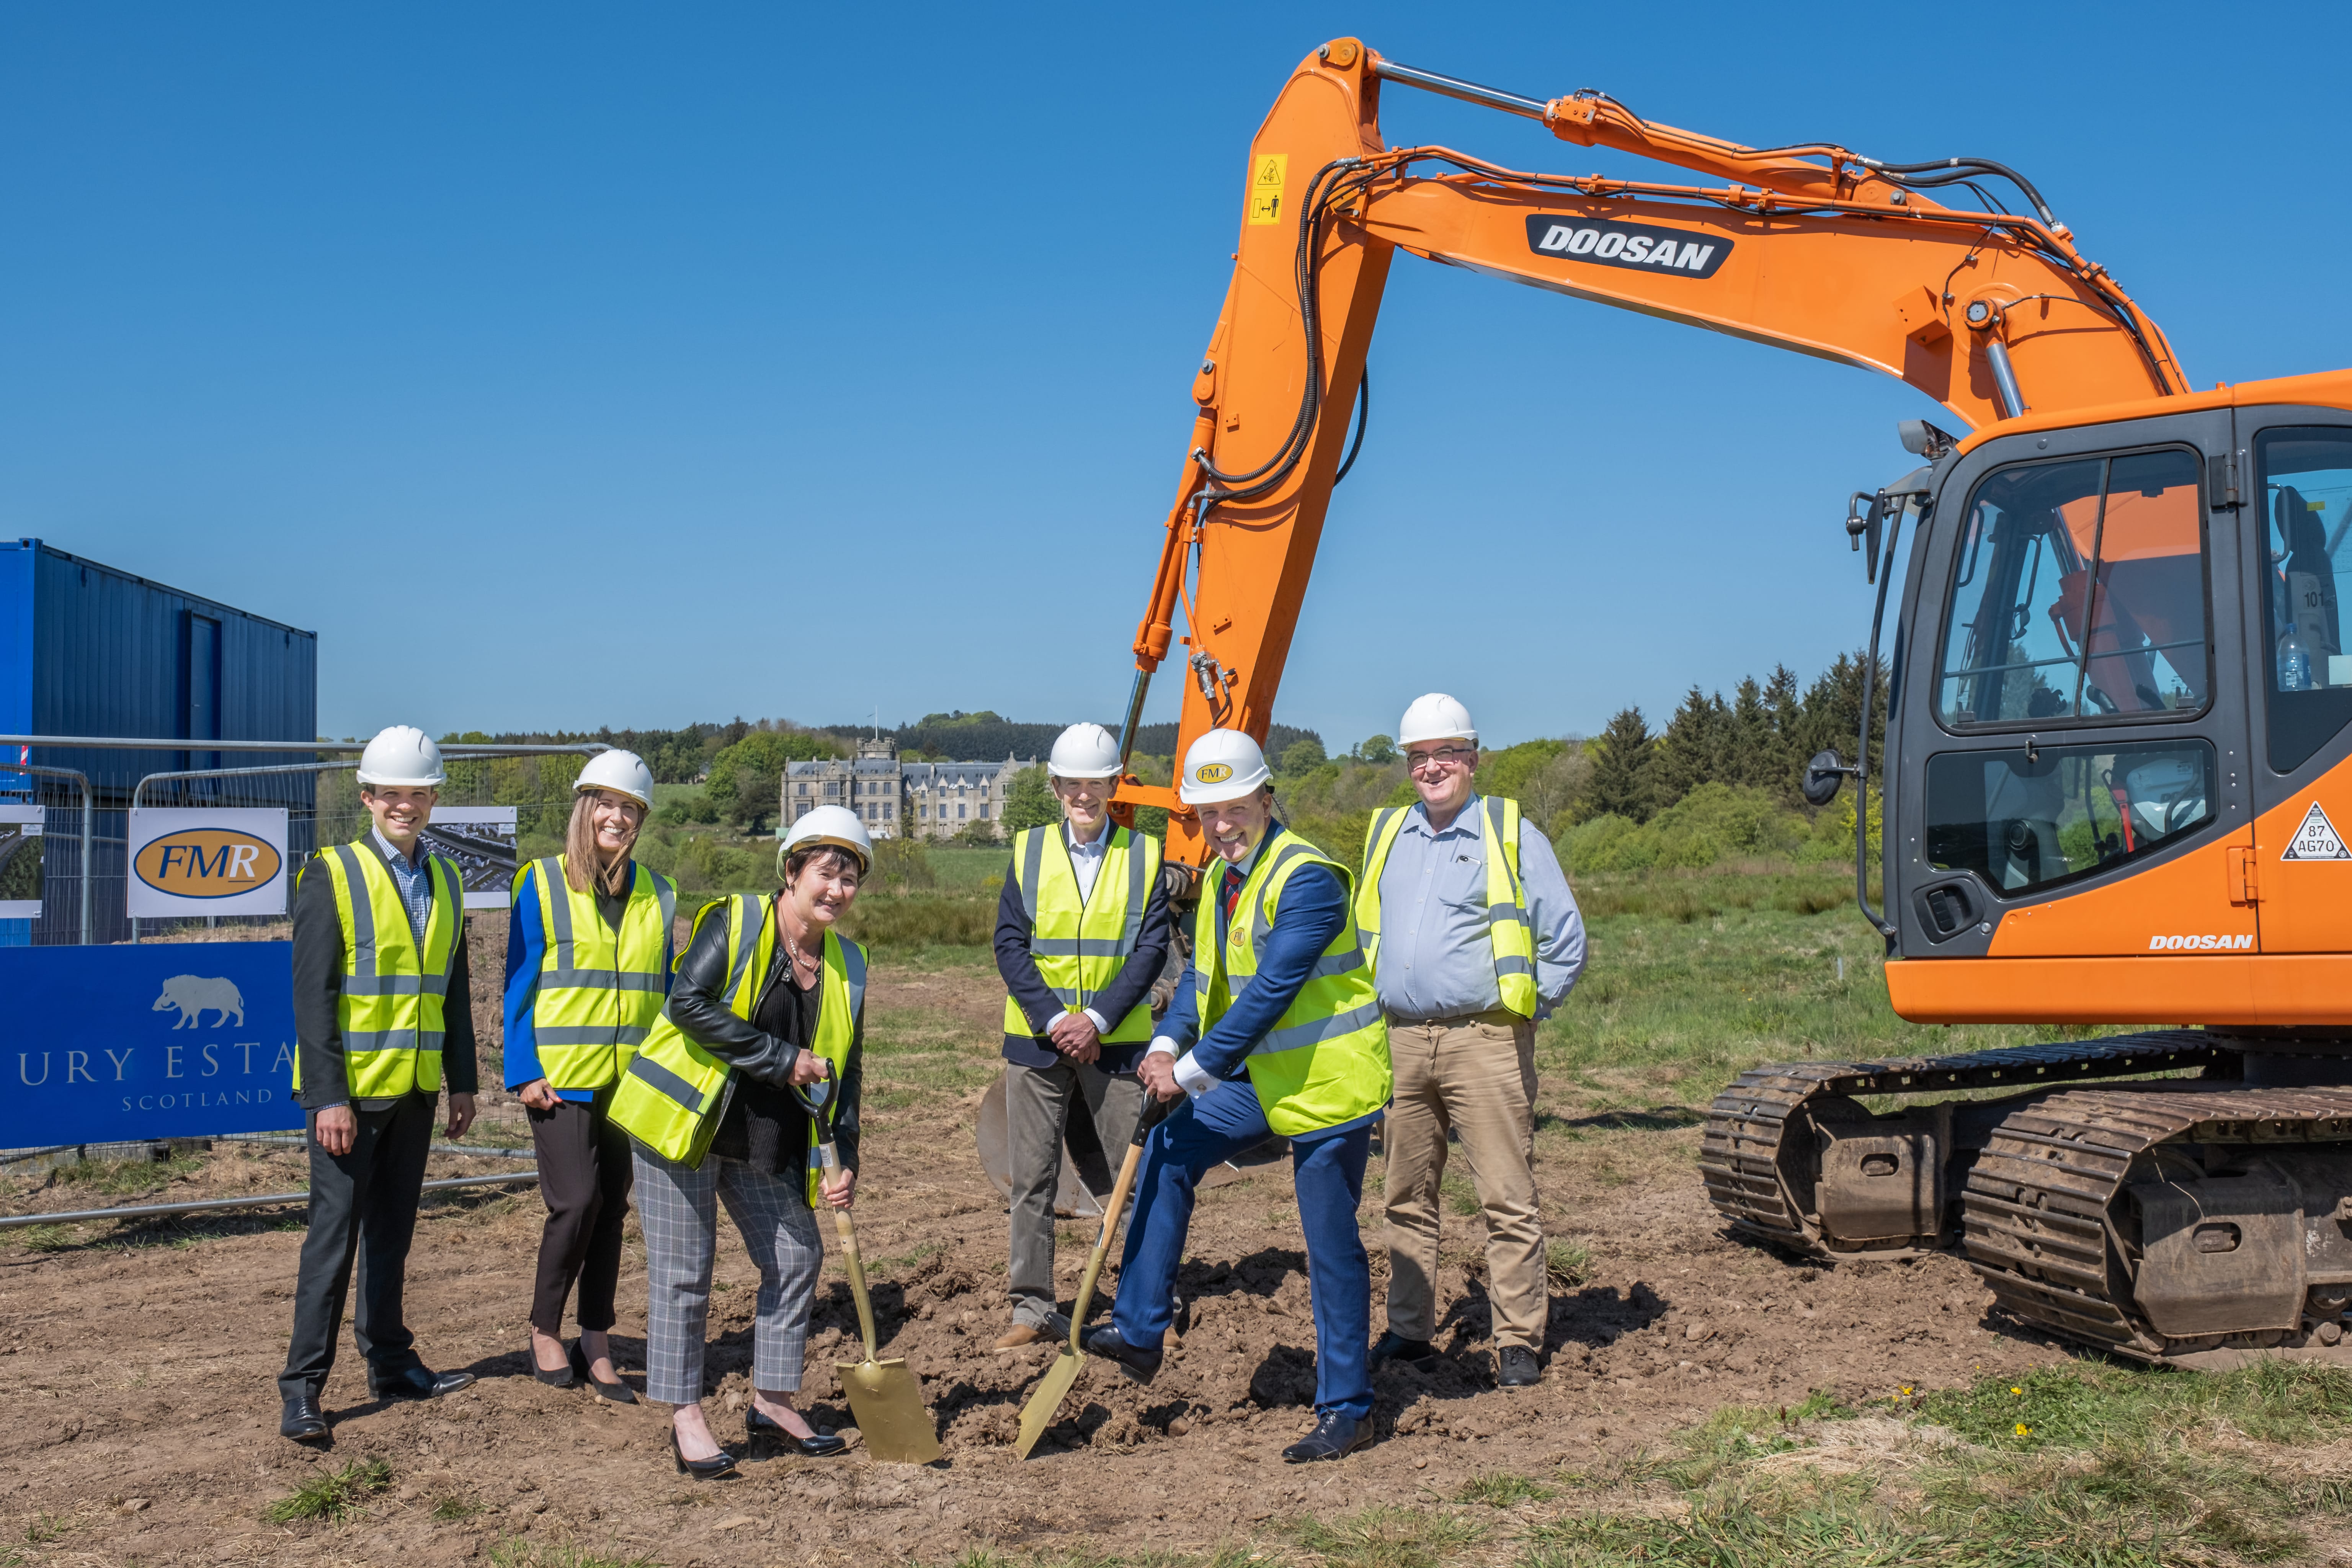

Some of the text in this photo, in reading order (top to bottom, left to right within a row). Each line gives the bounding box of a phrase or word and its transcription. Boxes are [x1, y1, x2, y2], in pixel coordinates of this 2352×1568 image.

[1539, 225, 1714, 270] DOOSAN
[2305, 591, 2323, 607] 101
[1202, 767, 1227, 779] FMR
[2309, 826, 2324, 836] 87
[2298, 840, 2334, 852] AG70
[158, 845, 259, 878] FMR
[2149, 935, 2253, 949] DOOSAN
[17, 1048, 134, 1085] URY
[122, 1089, 271, 1111] SCOTLAND
